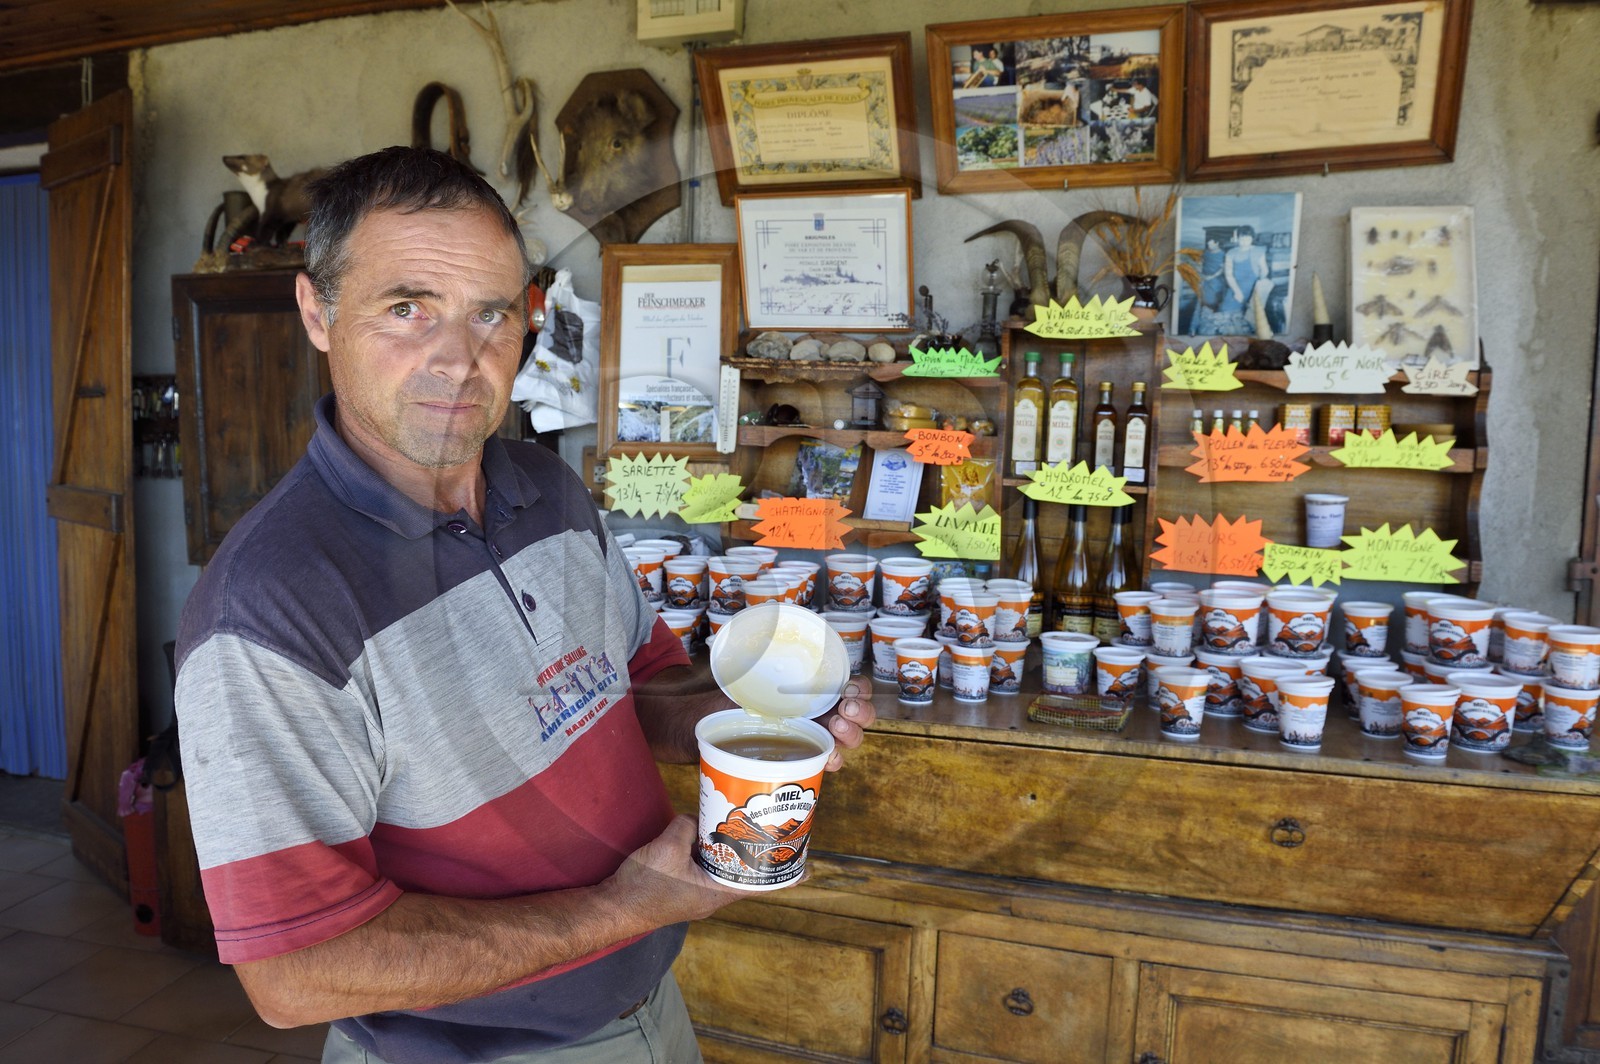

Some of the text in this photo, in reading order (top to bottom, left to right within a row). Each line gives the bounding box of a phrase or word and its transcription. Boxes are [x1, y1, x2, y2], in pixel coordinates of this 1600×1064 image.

[786, 109, 833, 119] DIPLÔME
[637, 297, 706, 309] FEINSCHMECKER
[1298, 354, 1350, 370] NOUGAT
[917, 431, 965, 443] BONBON
[621, 465, 678, 478] SARIETTE
[1045, 470, 1106, 488] HYDROMEL
[935, 514, 1000, 536] LAVANDE
[1177, 527, 1239, 546] FLEURS
[1269, 544, 1326, 560] ROMARIN
[1366, 537, 1436, 554] MONTAGNE
[540, 672, 620, 743] AMERICAN CITY
[564, 697, 610, 737] NAUTIC LINE
[774, 790, 802, 804] MIEL
[749, 810, 763, 821] des
[763, 803, 790, 816] GORGES
[789, 802, 798, 811] du
[714, 868, 735, 881] Michel
[737, 876, 776, 885] Apiculteurs
